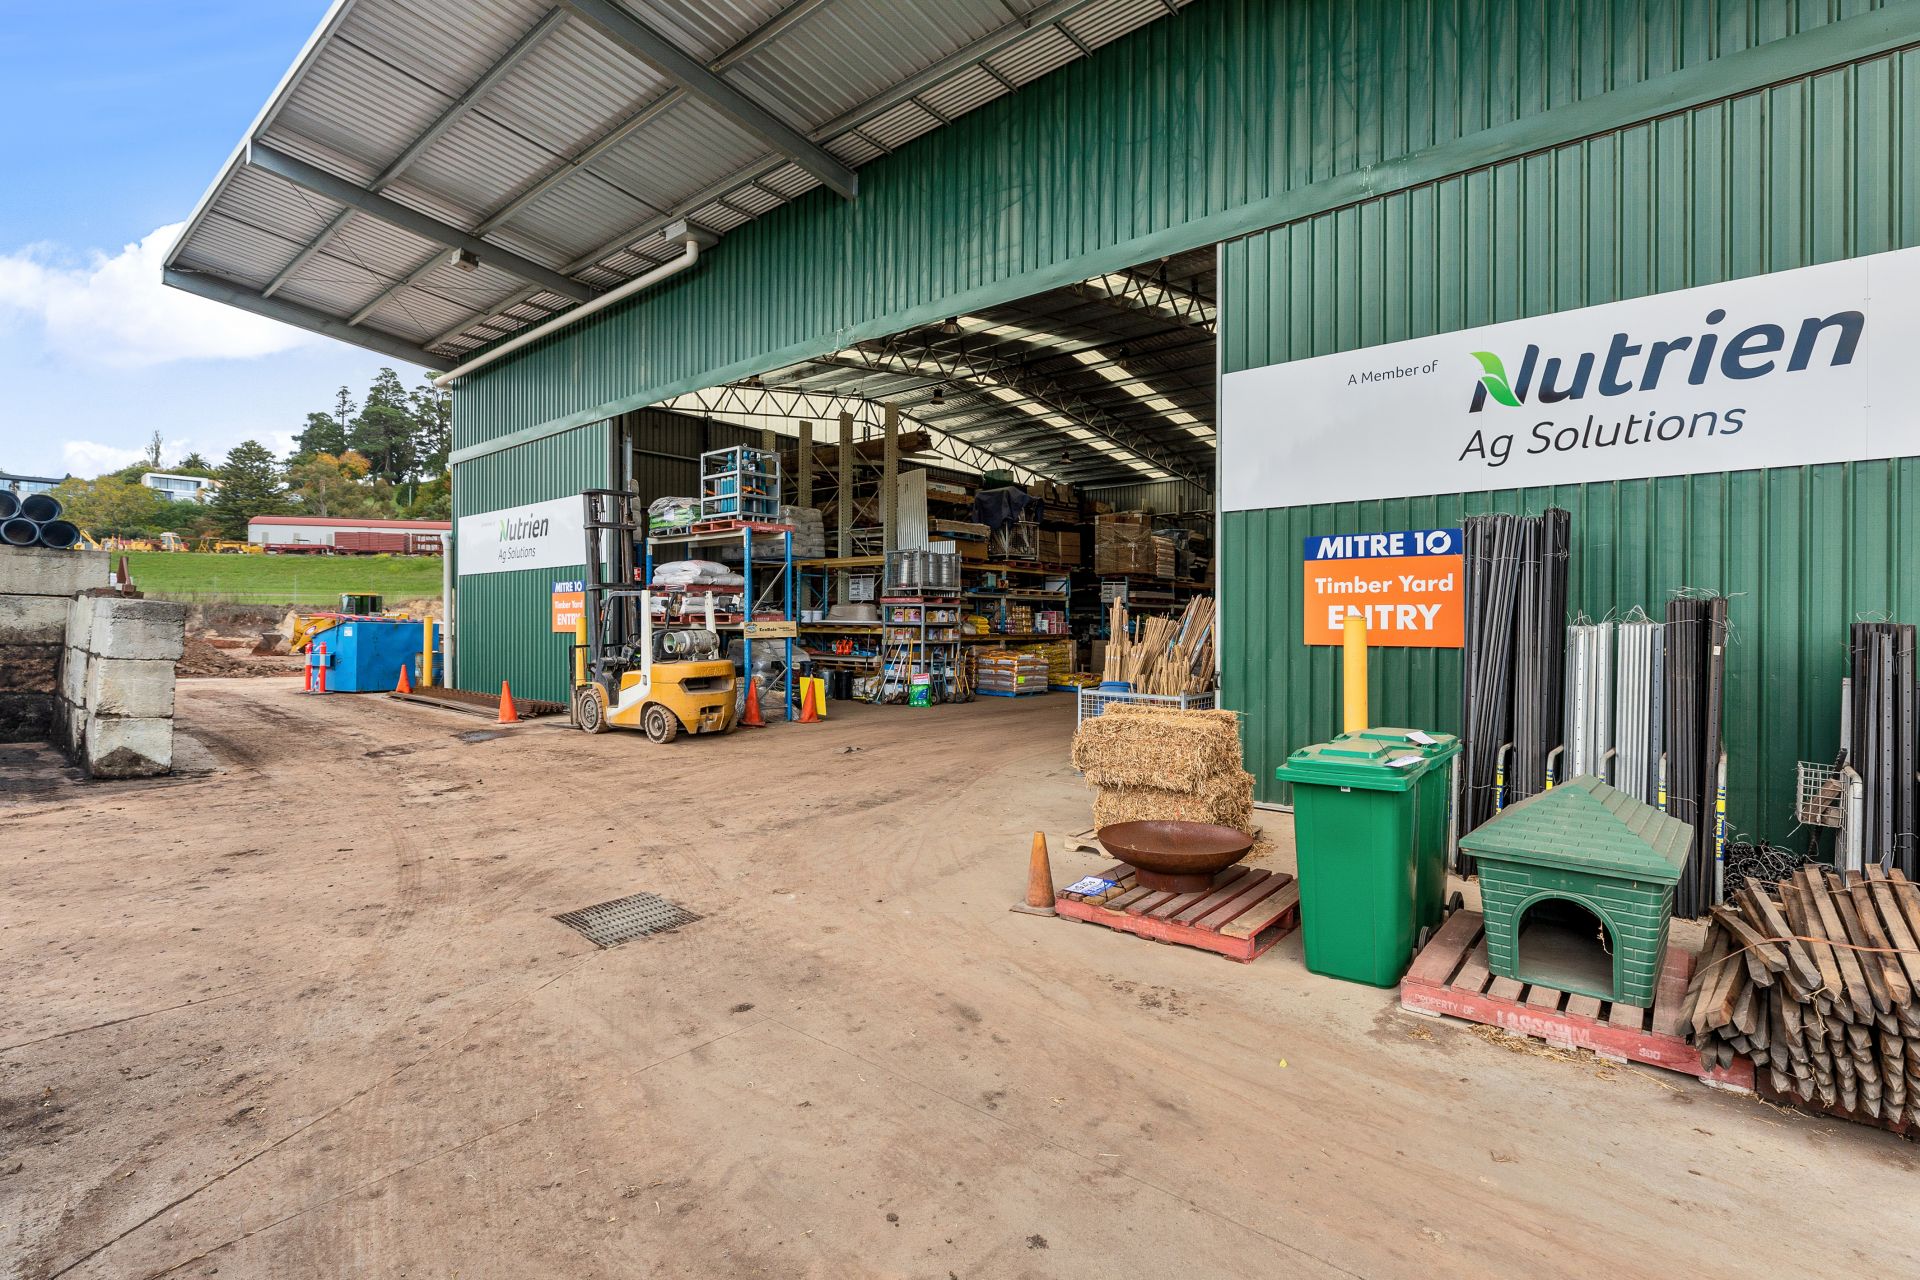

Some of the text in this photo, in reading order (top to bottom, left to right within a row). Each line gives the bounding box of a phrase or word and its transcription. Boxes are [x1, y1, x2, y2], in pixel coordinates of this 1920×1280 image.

[1347, 360, 1439, 386] A Member of
[1469, 308, 1865, 413] Nutrien
[1458, 407, 1747, 467] Ag Solutions
[499, 513, 549, 542] Nutrien
[498, 546, 536, 563] Ag Solutions
[1316, 530, 1452, 559] MITRE 10
[554, 580, 583, 593] MITRE 10
[1314, 573, 1454, 594] Timber Yard
[1414, 993, 1458, 1011] PROPERTY
